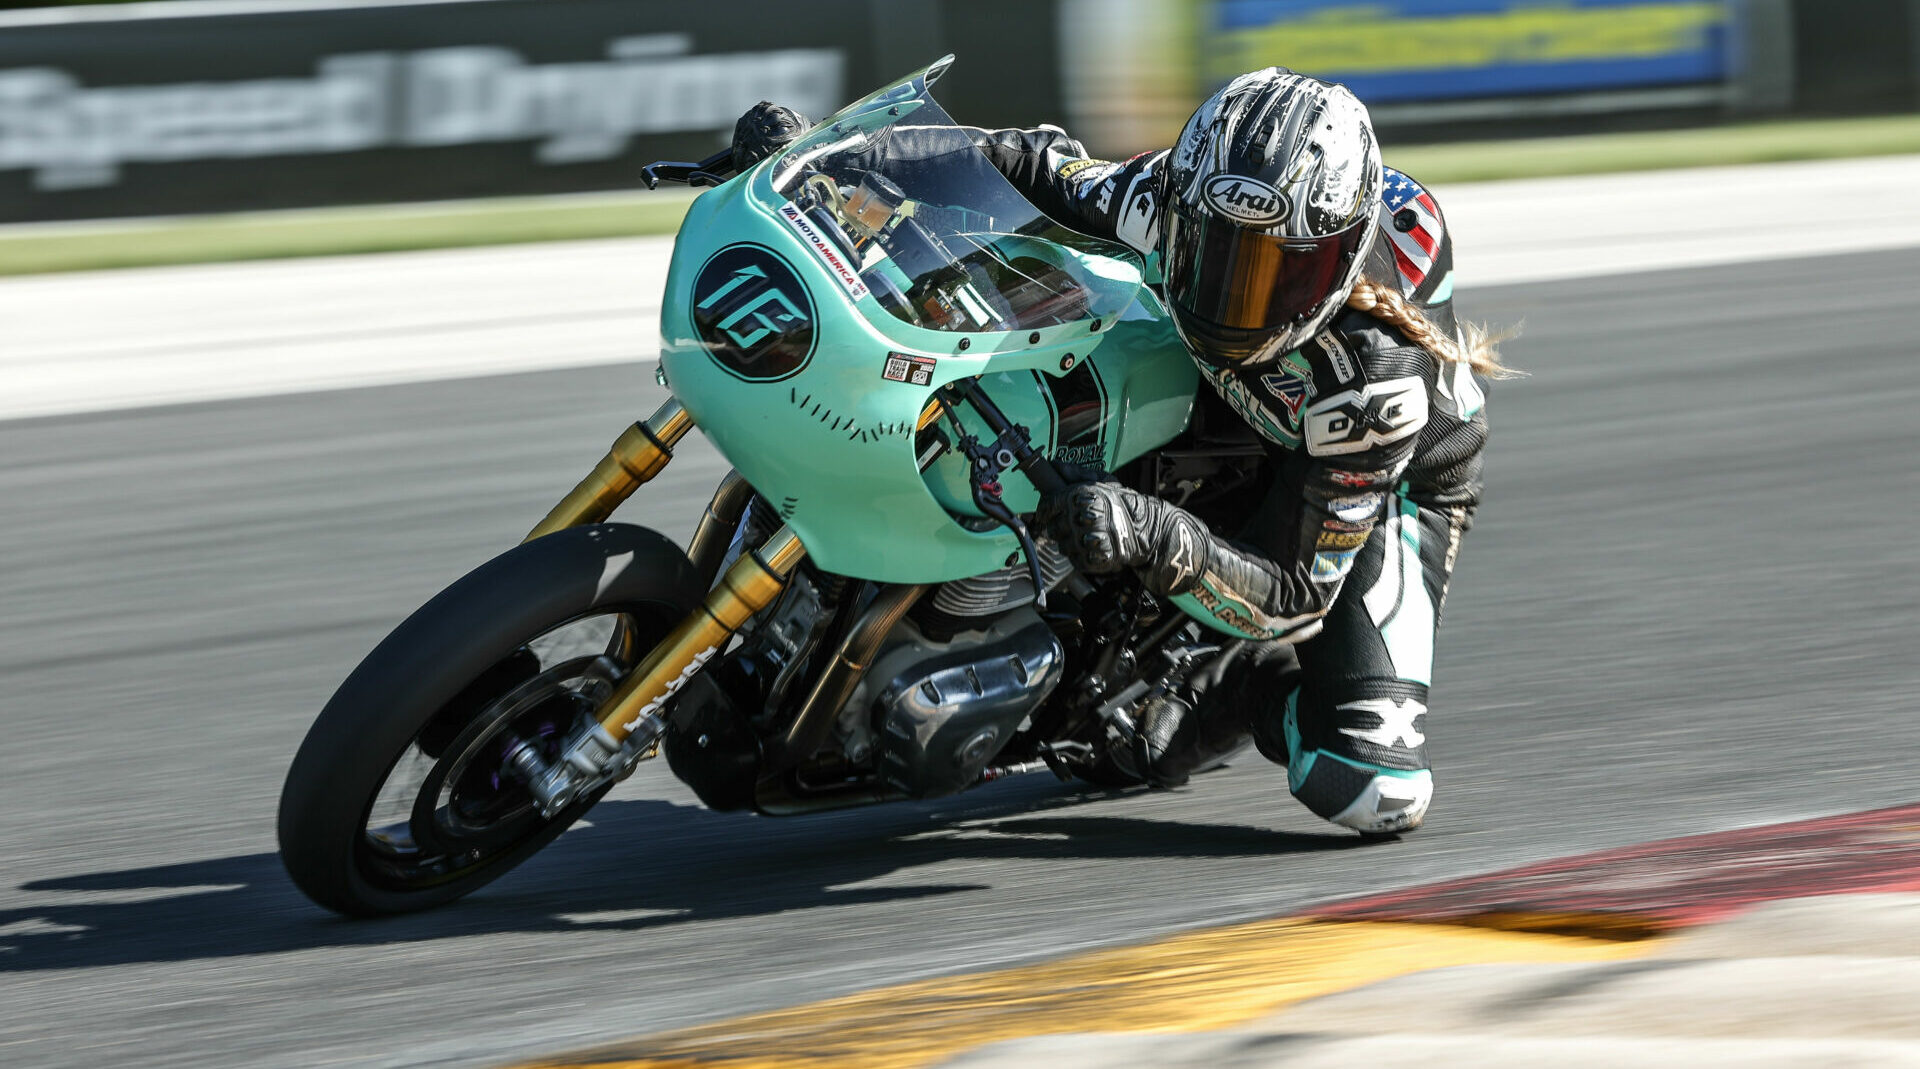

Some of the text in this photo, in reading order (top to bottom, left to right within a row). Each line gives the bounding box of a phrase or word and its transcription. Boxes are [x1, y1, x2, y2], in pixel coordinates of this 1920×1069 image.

[1210, 182, 1278, 213] Arai
[795, 219, 855, 285] MOTOAMERICA
[1320, 334, 1350, 379] DUNLOP
